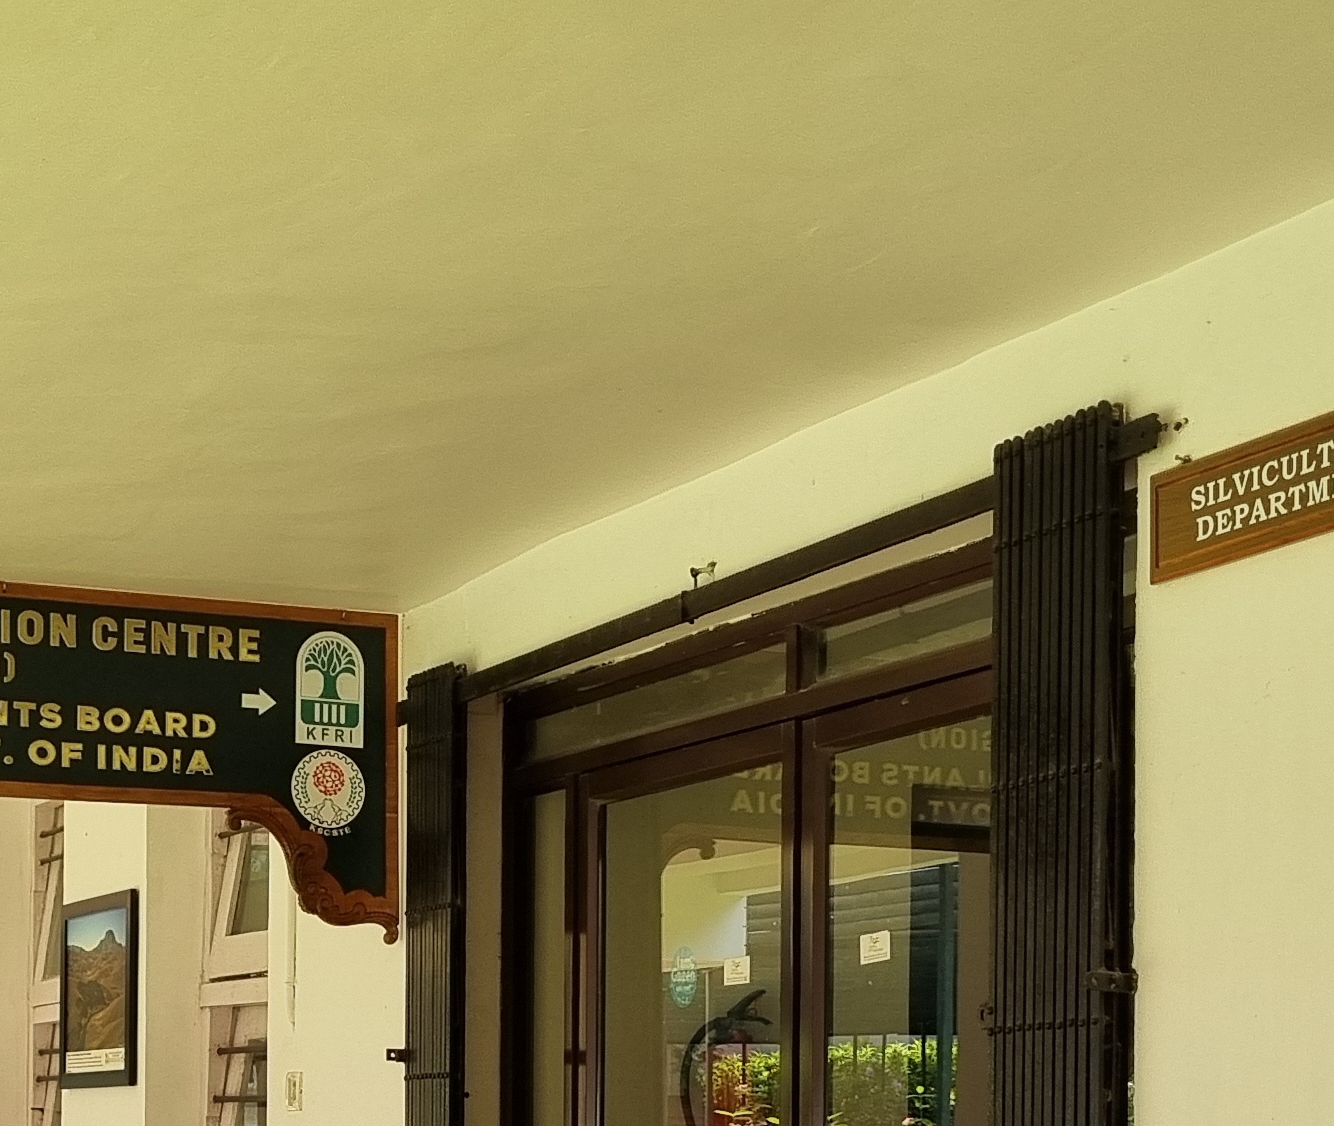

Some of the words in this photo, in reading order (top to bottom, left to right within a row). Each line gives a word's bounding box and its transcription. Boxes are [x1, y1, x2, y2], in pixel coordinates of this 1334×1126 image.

[91, 616, 261, 663] CENTRE
[76, 704, 217, 739] BOARD
[306, 726, 353, 744] KFRI
[27, 739, 84, 768] OF
[97, 744, 214, 776] INDIA
[308, 823, 352, 837] KSCSTE
